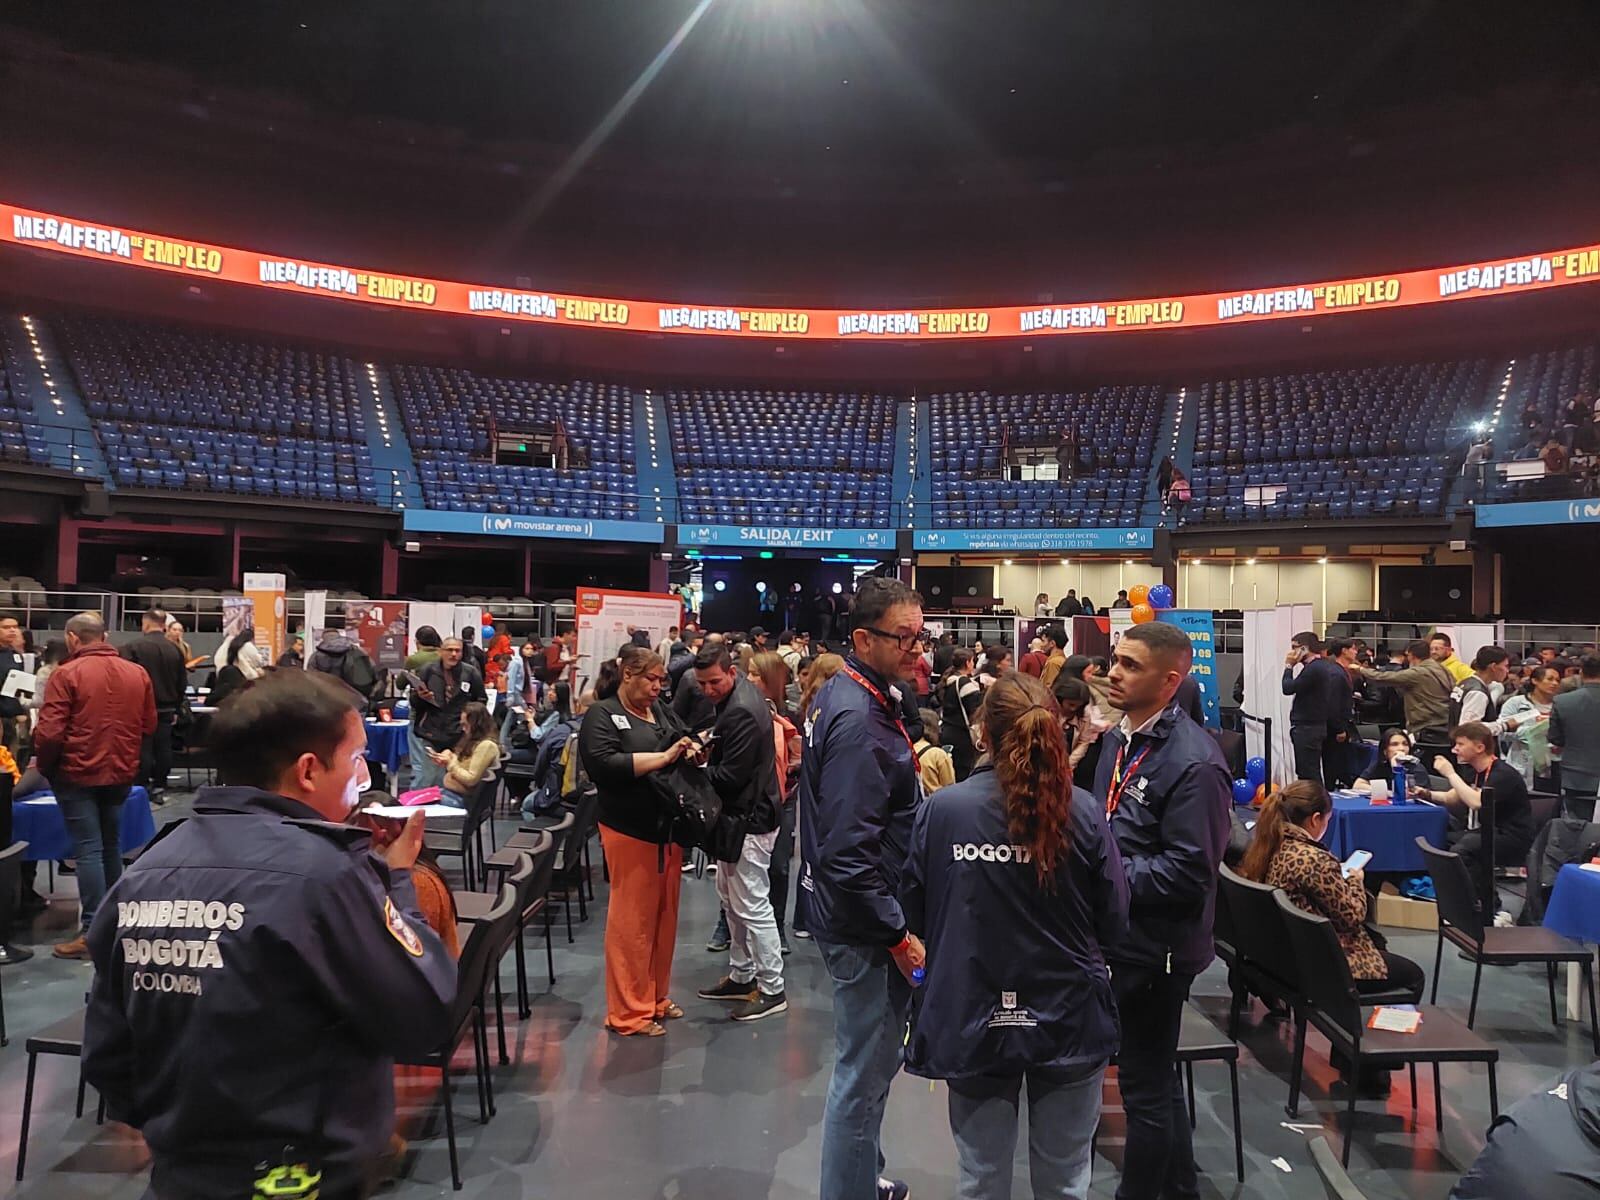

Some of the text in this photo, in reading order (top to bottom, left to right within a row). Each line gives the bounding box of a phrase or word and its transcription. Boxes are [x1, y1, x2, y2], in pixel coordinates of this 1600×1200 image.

[13, 214, 223, 273] MEGAFERIA DE EMPLEO
[259, 260, 436, 305] MEGAFERIA DE EMPLEO
[1439, 250, 1600, 297] MEGAFERIA DE EM
[469, 290, 630, 325] MEGAFERIA DE EMPLEO
[1218, 279, 1400, 319] MEGAFERIA DE EMPLEO
[659, 307, 809, 334] MEGAFERIA DE EMPLEO
[838, 312, 988, 335] MEGAFERIA DE EMPLEO
[1020, 301, 1184, 332] MEGAFERIA DE EMPLEO
[513, 520, 582, 533] movistar arena
[740, 528, 834, 541] SALIDA / EXIT
[969, 540, 1000, 549] repórtala
[117, 900, 245, 930] BOMBEROS
[121, 930, 224, 968] BOGOTÁ
